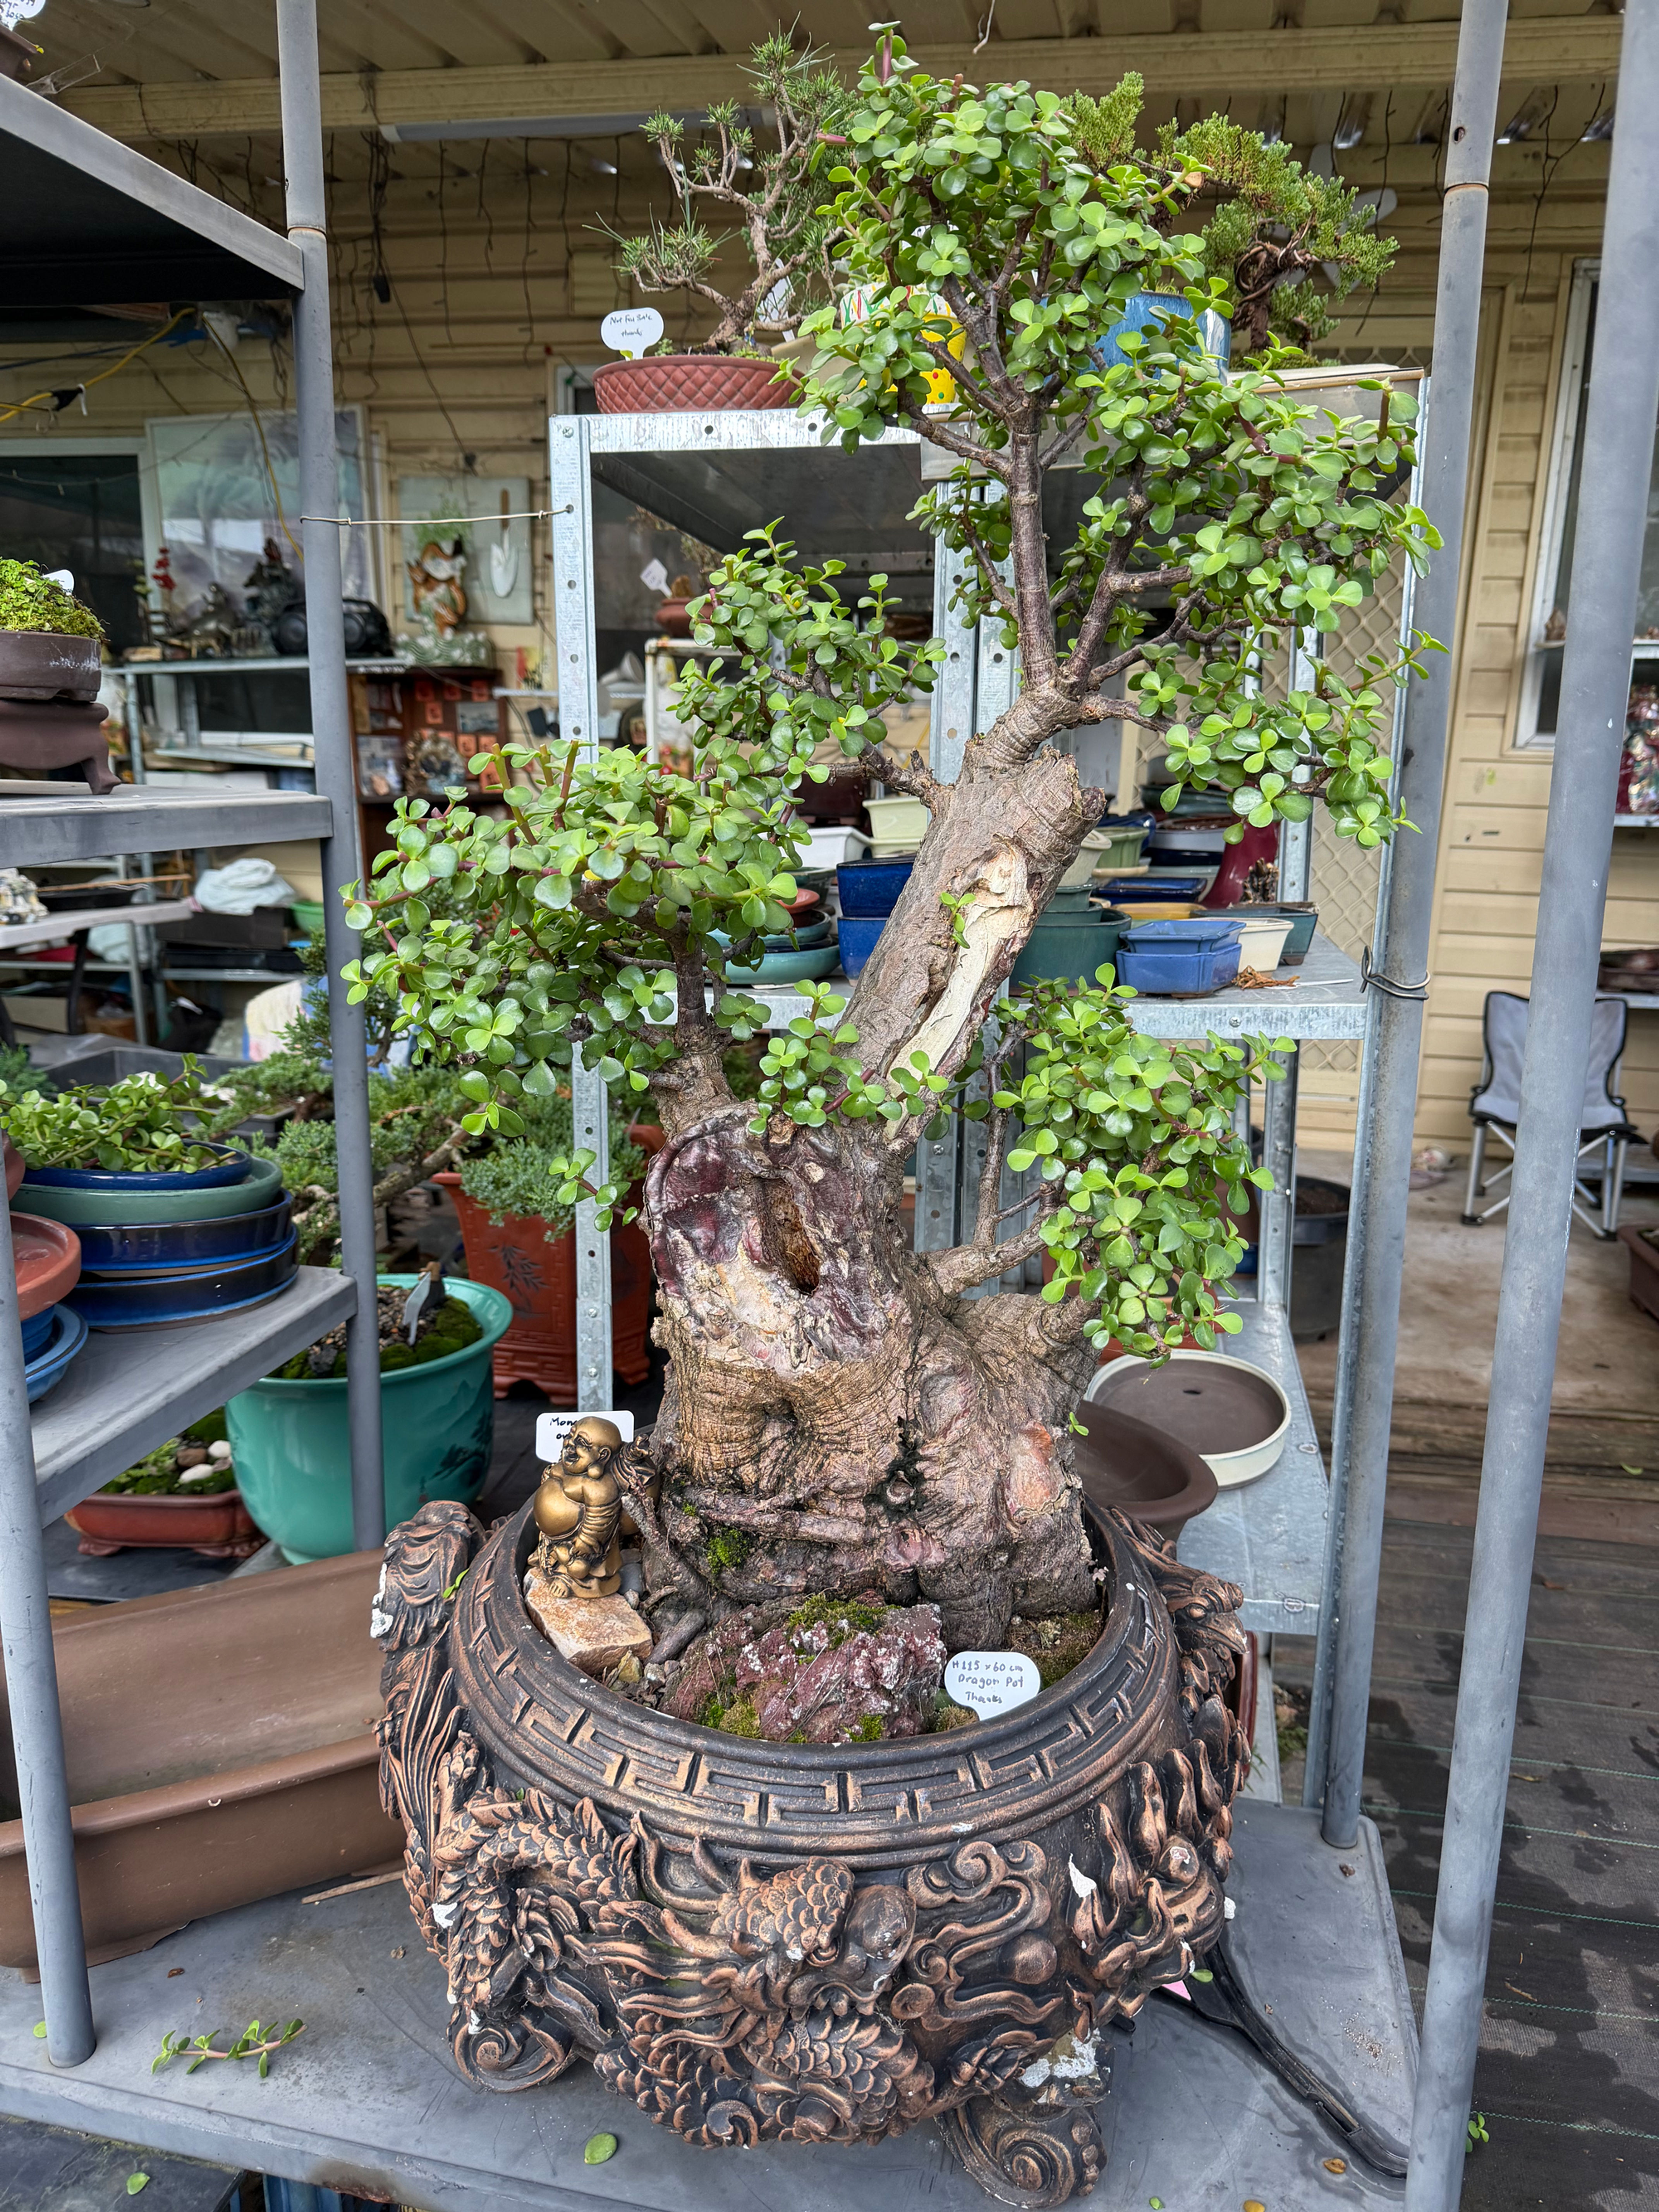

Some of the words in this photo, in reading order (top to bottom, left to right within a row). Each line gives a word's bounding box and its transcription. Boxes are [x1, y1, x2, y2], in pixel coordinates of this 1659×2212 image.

[550, 1417, 577, 1426] Mon
[958, 1673, 999, 1689] Dragon
[1006, 1676, 1023, 1687] Pot
[965, 1691, 1002, 1704] Thanks
